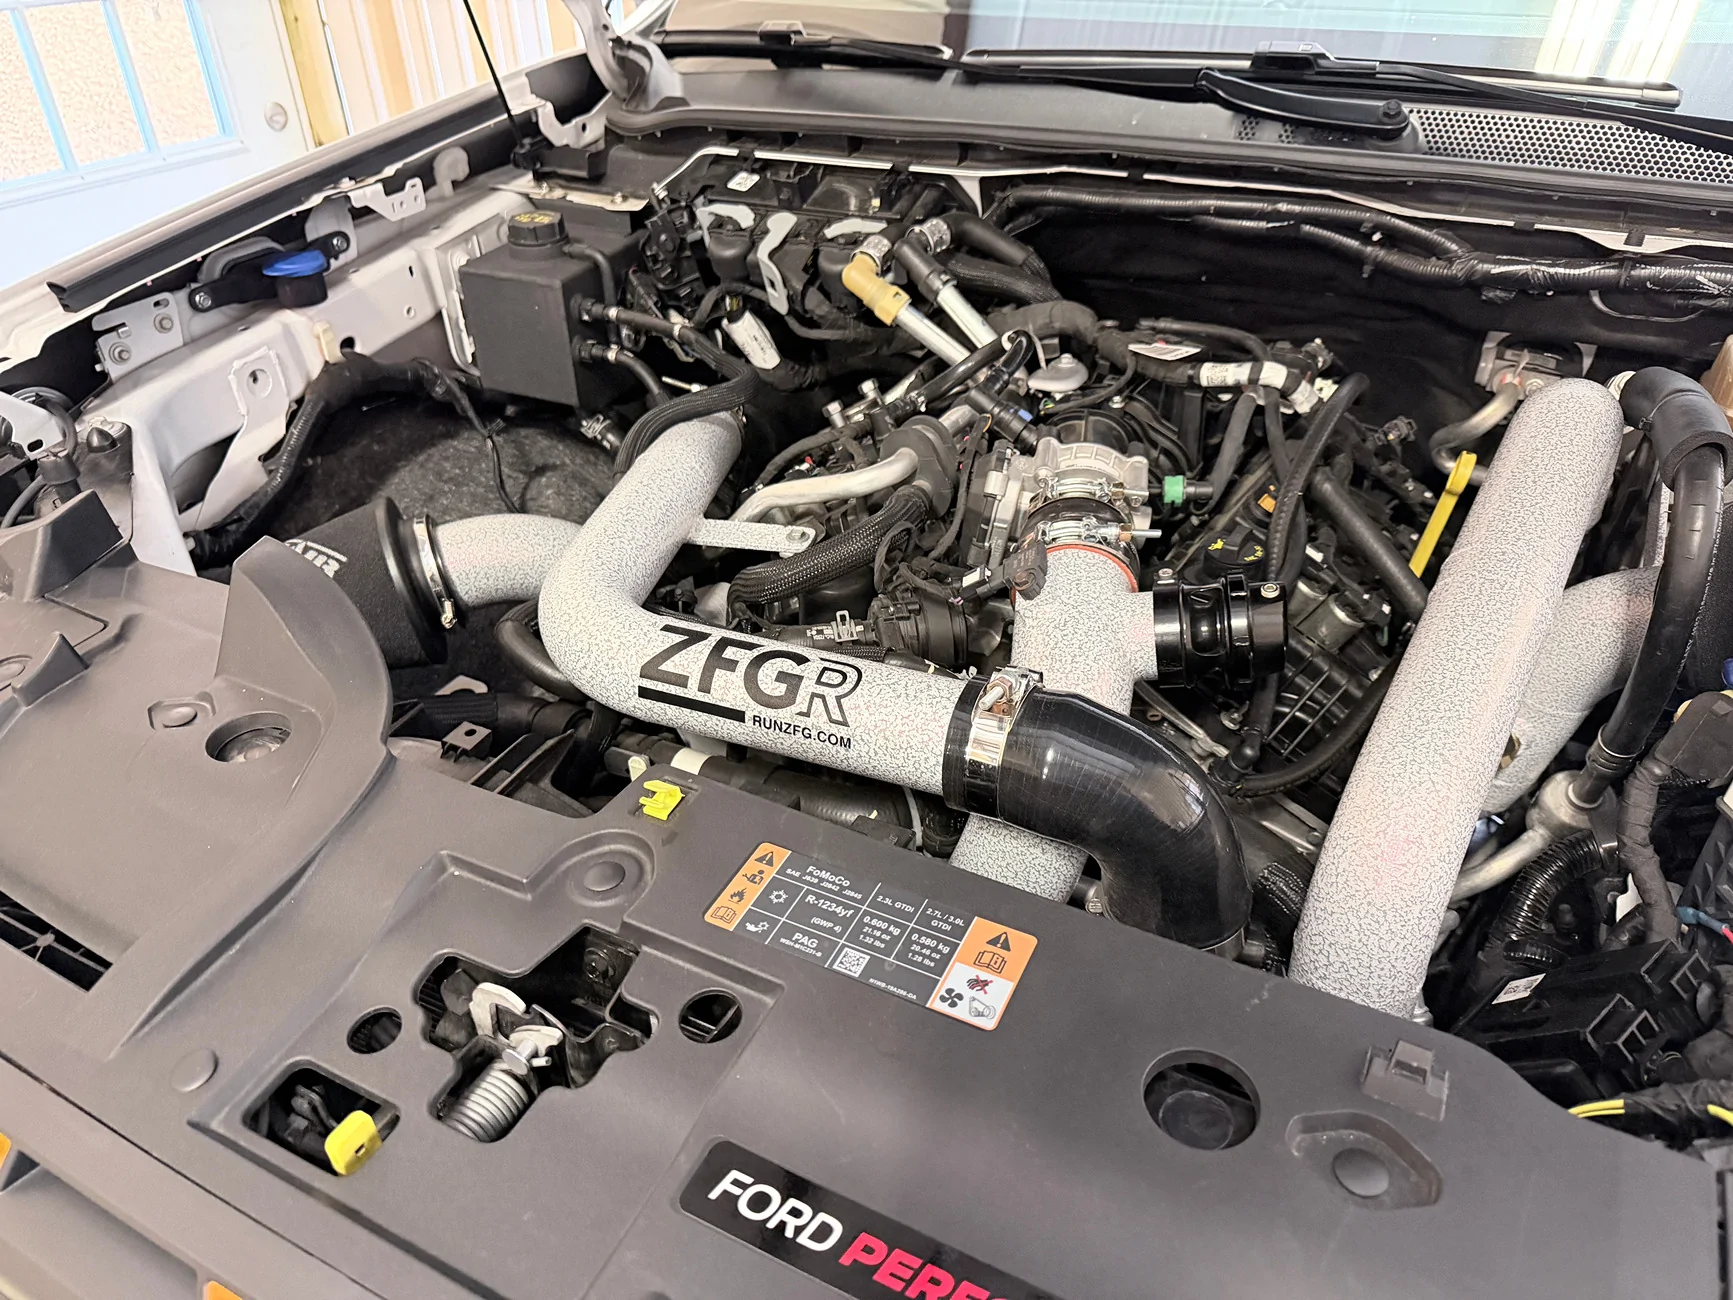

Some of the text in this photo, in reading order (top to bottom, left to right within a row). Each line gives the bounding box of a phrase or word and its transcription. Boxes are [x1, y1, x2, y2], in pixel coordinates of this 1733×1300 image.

[639, 623, 863, 728] ZFGR
[752, 714, 852, 749] RUNZFG.COM
[785, 868, 802, 878] SAE
[802, 874, 819, 884] J639
[806, 865, 851, 887] FoMoCo
[804, 894, 855, 918] R-1234yf
[876, 895, 893, 906] 2.3L
[810, 916, 842, 934] (GWP 4)
[863, 915, 901, 936] 0.600 kg
[925, 907, 942, 920] 2.7L
[948, 915, 965, 927] 3.0L
[791, 932, 819, 948] PAG
[859, 934, 886, 949] 1.32 lbs
[862, 926, 892, 941] 21.16 oz
[910, 943, 942, 960] 20.46 oz
[911, 933, 951, 954] 0.580 kg
[907, 952, 936, 967] 1.28 lbs
[707, 1169, 843, 1252] FORD
